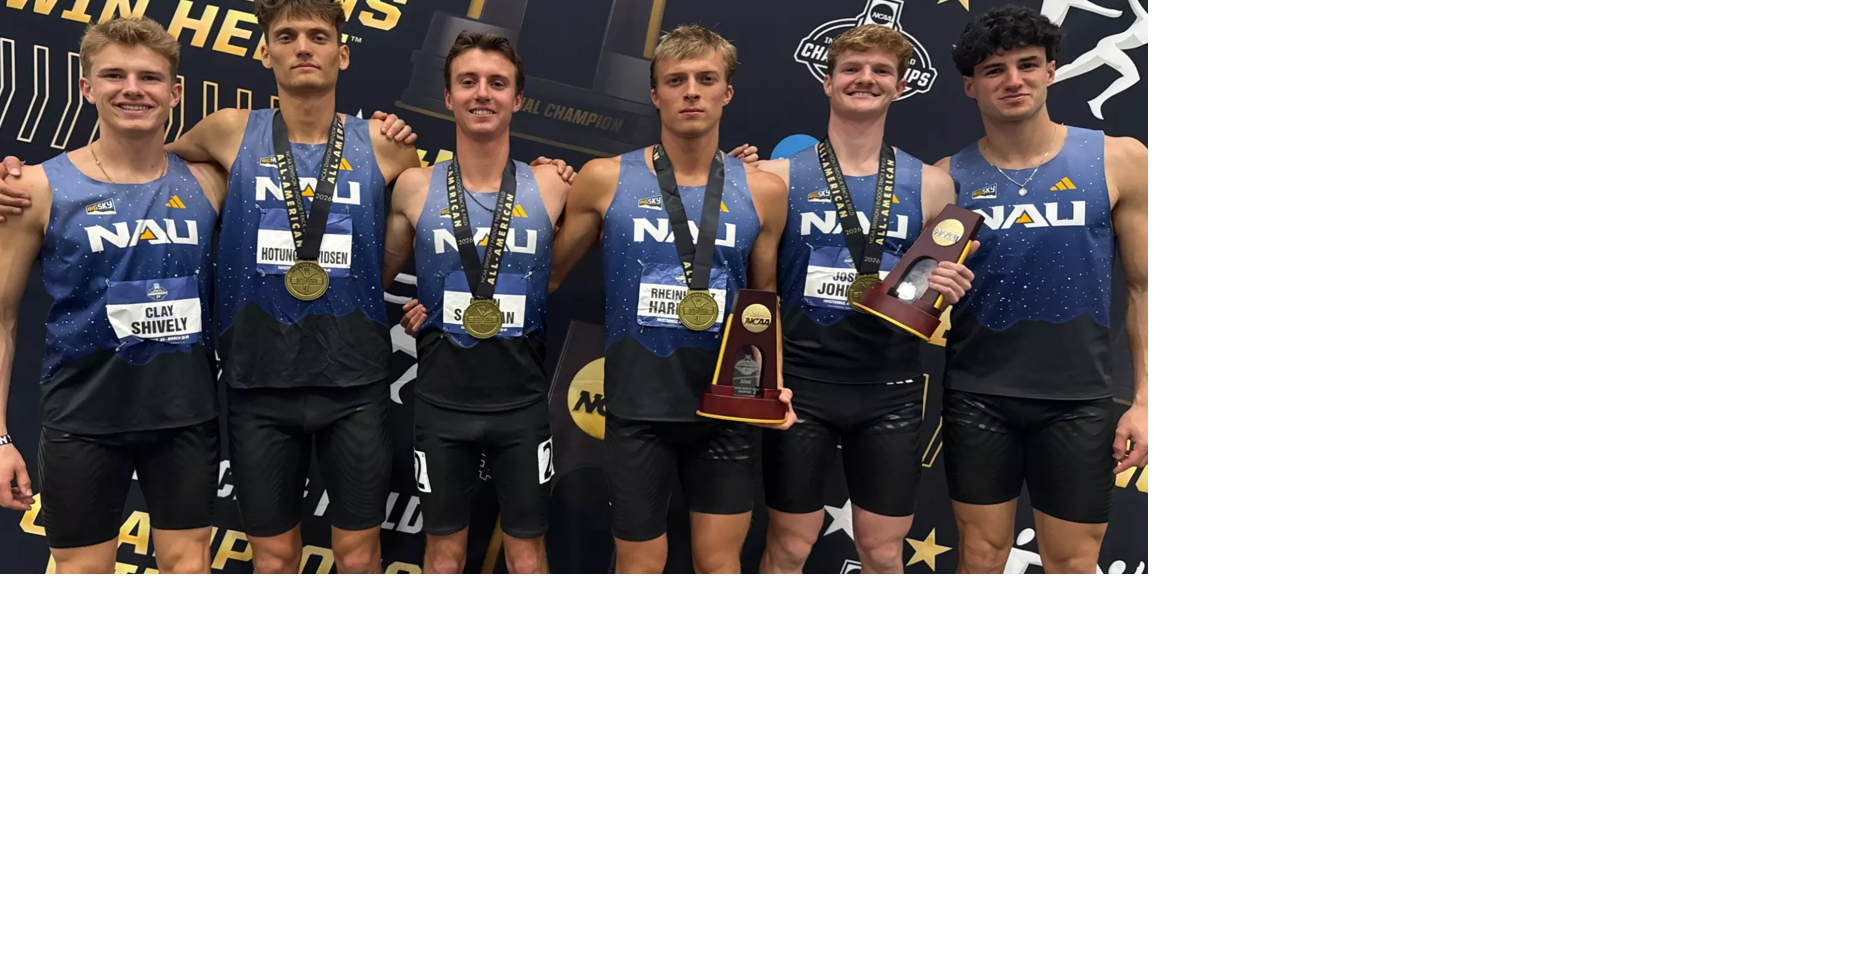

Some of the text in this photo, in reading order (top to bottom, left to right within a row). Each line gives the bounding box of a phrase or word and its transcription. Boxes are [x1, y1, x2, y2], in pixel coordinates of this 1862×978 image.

[871, 12, 893, 22] NCAA
[543, 103, 624, 133] CHAMPION
[277, 154, 303, 248] ALL-AMERICAN
[315, 193, 333, 201] 2026
[875, 159, 894, 245] ALL-AMERICAN
[972, 201, 1085, 230] NAU
[84, 218, 198, 253] NAU
[487, 193, 514, 285] ALL-AMERICAN
[845, 226, 861, 235] 2026
[864, 256, 880, 264] 2026
[145, 305, 173, 318] CLAY
[744, 317, 769, 326] NCAA
[131, 317, 187, 335] SHIVELY
[542, 441, 553, 480] 2
